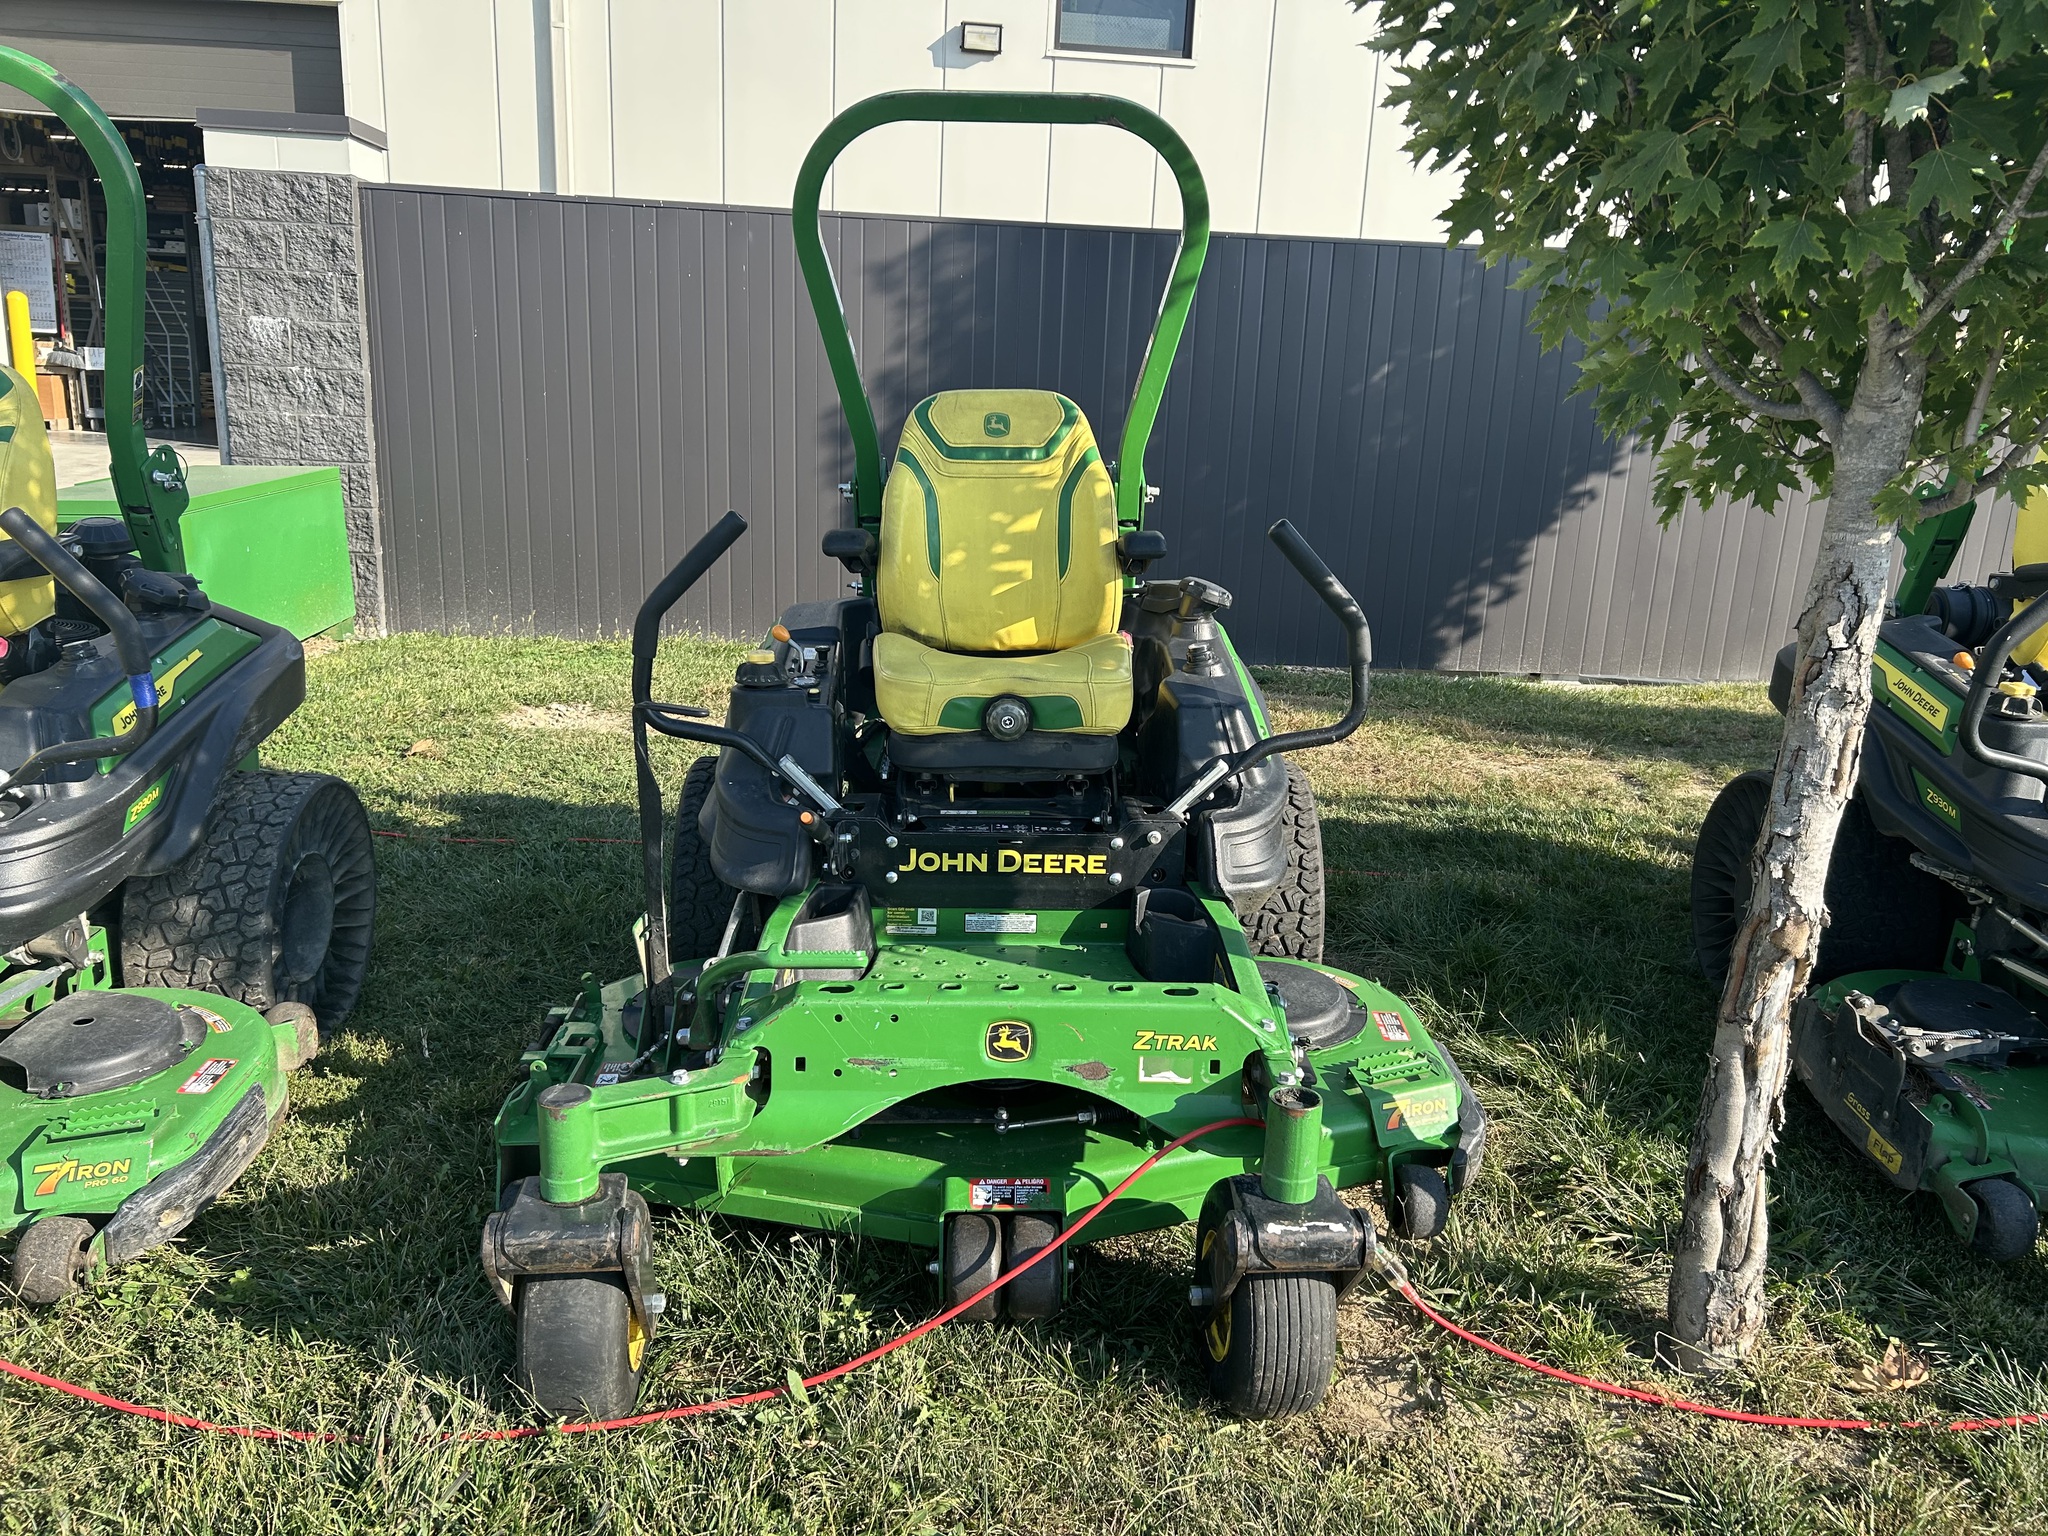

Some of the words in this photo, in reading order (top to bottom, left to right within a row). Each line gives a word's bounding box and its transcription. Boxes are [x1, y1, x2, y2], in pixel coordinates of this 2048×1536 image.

[1893, 678, 1915, 698] JOHN
[1912, 692, 1940, 718] DEERE
[120, 708, 138, 729] JOH
[130, 787, 159, 823] Z930M
[1926, 788, 1956, 819] Z930M
[899, 848, 988, 872] JOHN
[997, 849, 1107, 875] DEERE
[1132, 1030, 1218, 1051] ZTRAK
[1847, 1092, 1871, 1120] Grass
[1873, 1138, 1894, 1164] Flap
[84, 1178, 109, 1189] PRO
[111, 1175, 129, 1184] 60
